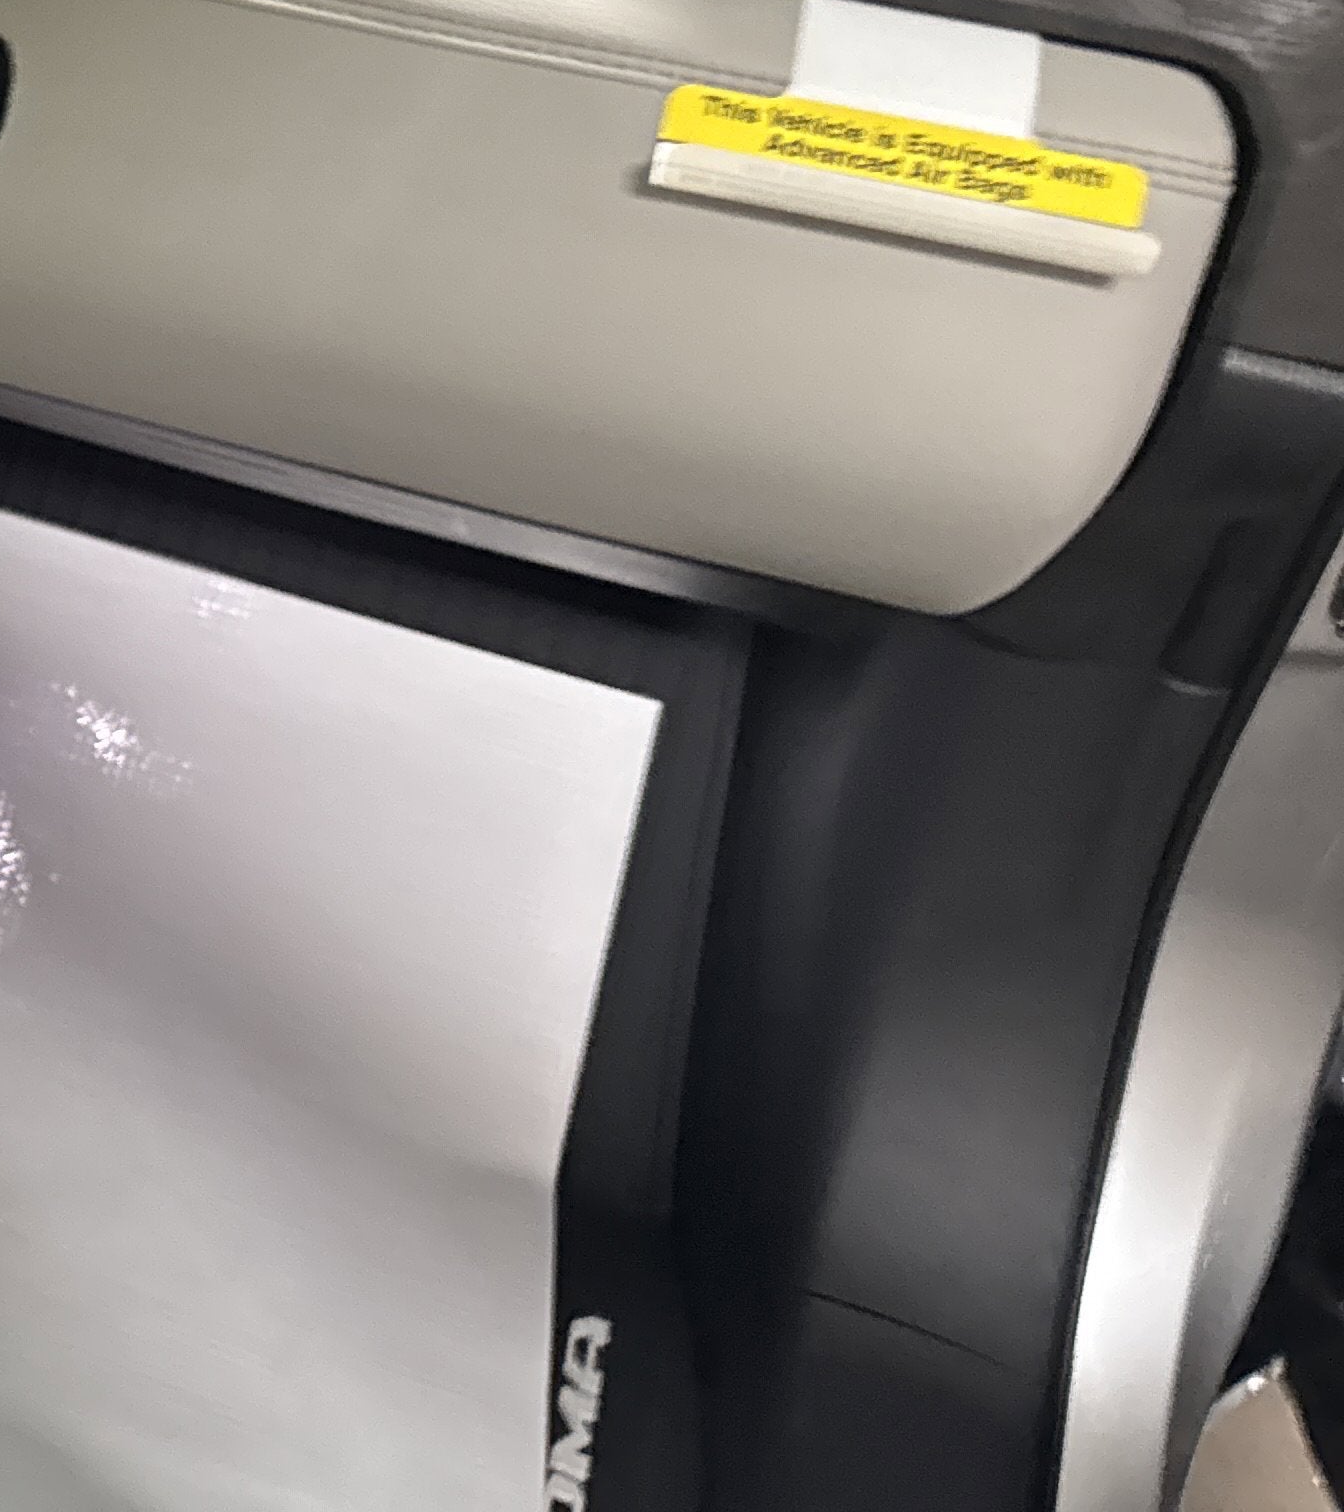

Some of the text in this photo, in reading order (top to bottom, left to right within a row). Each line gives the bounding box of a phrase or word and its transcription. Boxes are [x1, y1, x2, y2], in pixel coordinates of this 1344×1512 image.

[700, 93, 1114, 191] This Vehicle is Equipped with
[760, 133, 1033, 206] Advanced Air Bags
